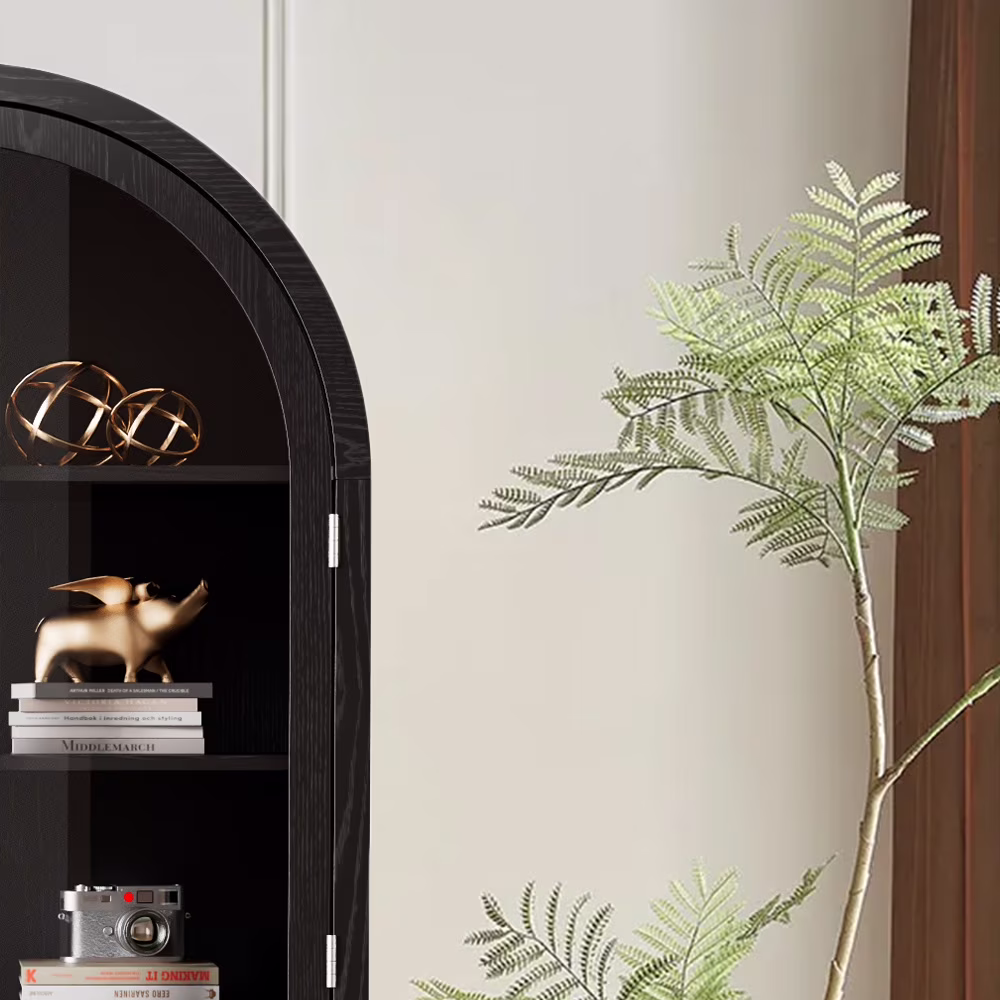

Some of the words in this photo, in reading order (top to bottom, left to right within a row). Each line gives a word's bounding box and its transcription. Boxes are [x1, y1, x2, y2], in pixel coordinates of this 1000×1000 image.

[61, 739, 155, 752] MIDDLEMARCH
[25, 969, 37, 983] K
[145, 970, 158, 981] IT
[161, 970, 210, 981] MAKING
[114, 990, 150, 998] SAARINEN
[152, 990, 170, 998] EERO
